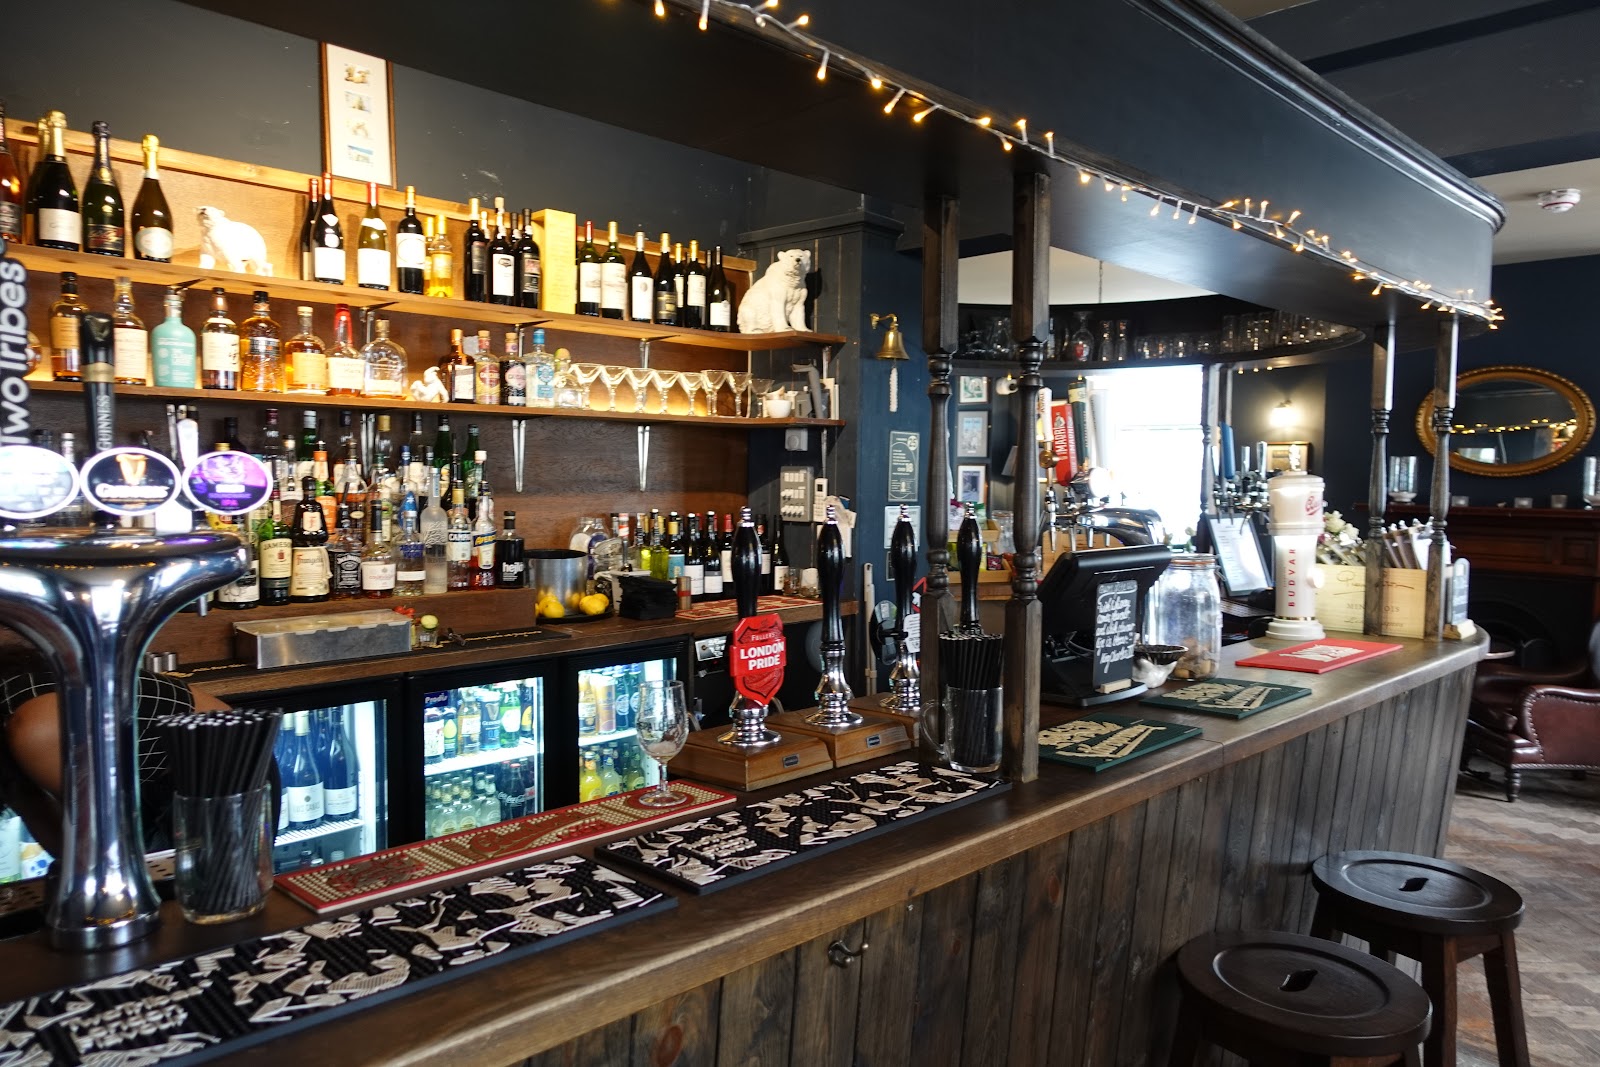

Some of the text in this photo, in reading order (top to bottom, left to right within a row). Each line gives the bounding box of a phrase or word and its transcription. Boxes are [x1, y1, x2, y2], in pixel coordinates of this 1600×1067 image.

[96, 395, 112, 451] GUINNESS
[1288, 549, 1296, 607] BUDVAR
[740, 641, 784, 660] LONDON
[748, 654, 780, 671] PRIDE
